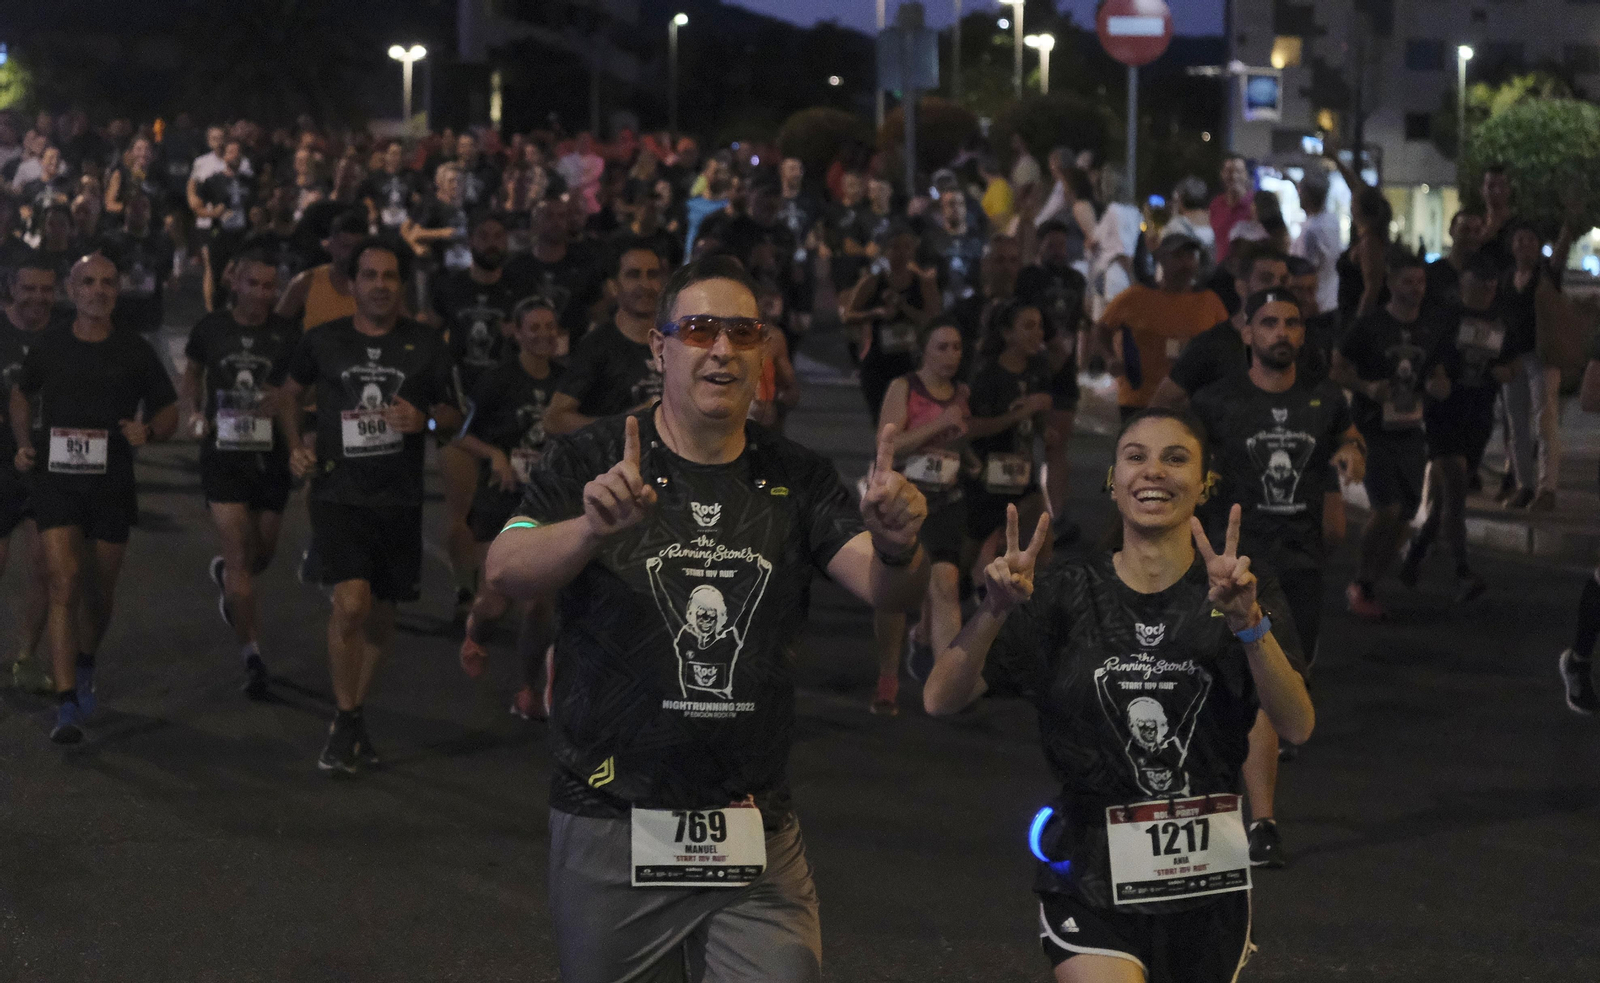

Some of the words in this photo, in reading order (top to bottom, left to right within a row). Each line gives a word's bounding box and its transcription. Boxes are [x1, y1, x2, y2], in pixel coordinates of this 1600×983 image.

[66, 437, 89, 454] 951
[690, 501, 722, 517] Rock
[690, 534, 716, 547] the
[659, 543, 714, 567] Running
[1134, 622, 1166, 636] Rock
[1130, 653, 1156, 663] the
[693, 664, 718, 678] Rock
[1104, 656, 1153, 680] Running
[662, 699, 735, 712] NIGHTRUNNING
[735, 702, 756, 712] 2022
[672, 810, 727, 843] 769
[1145, 817, 1210, 857] 1217
[685, 844, 718, 854] MANUEL
